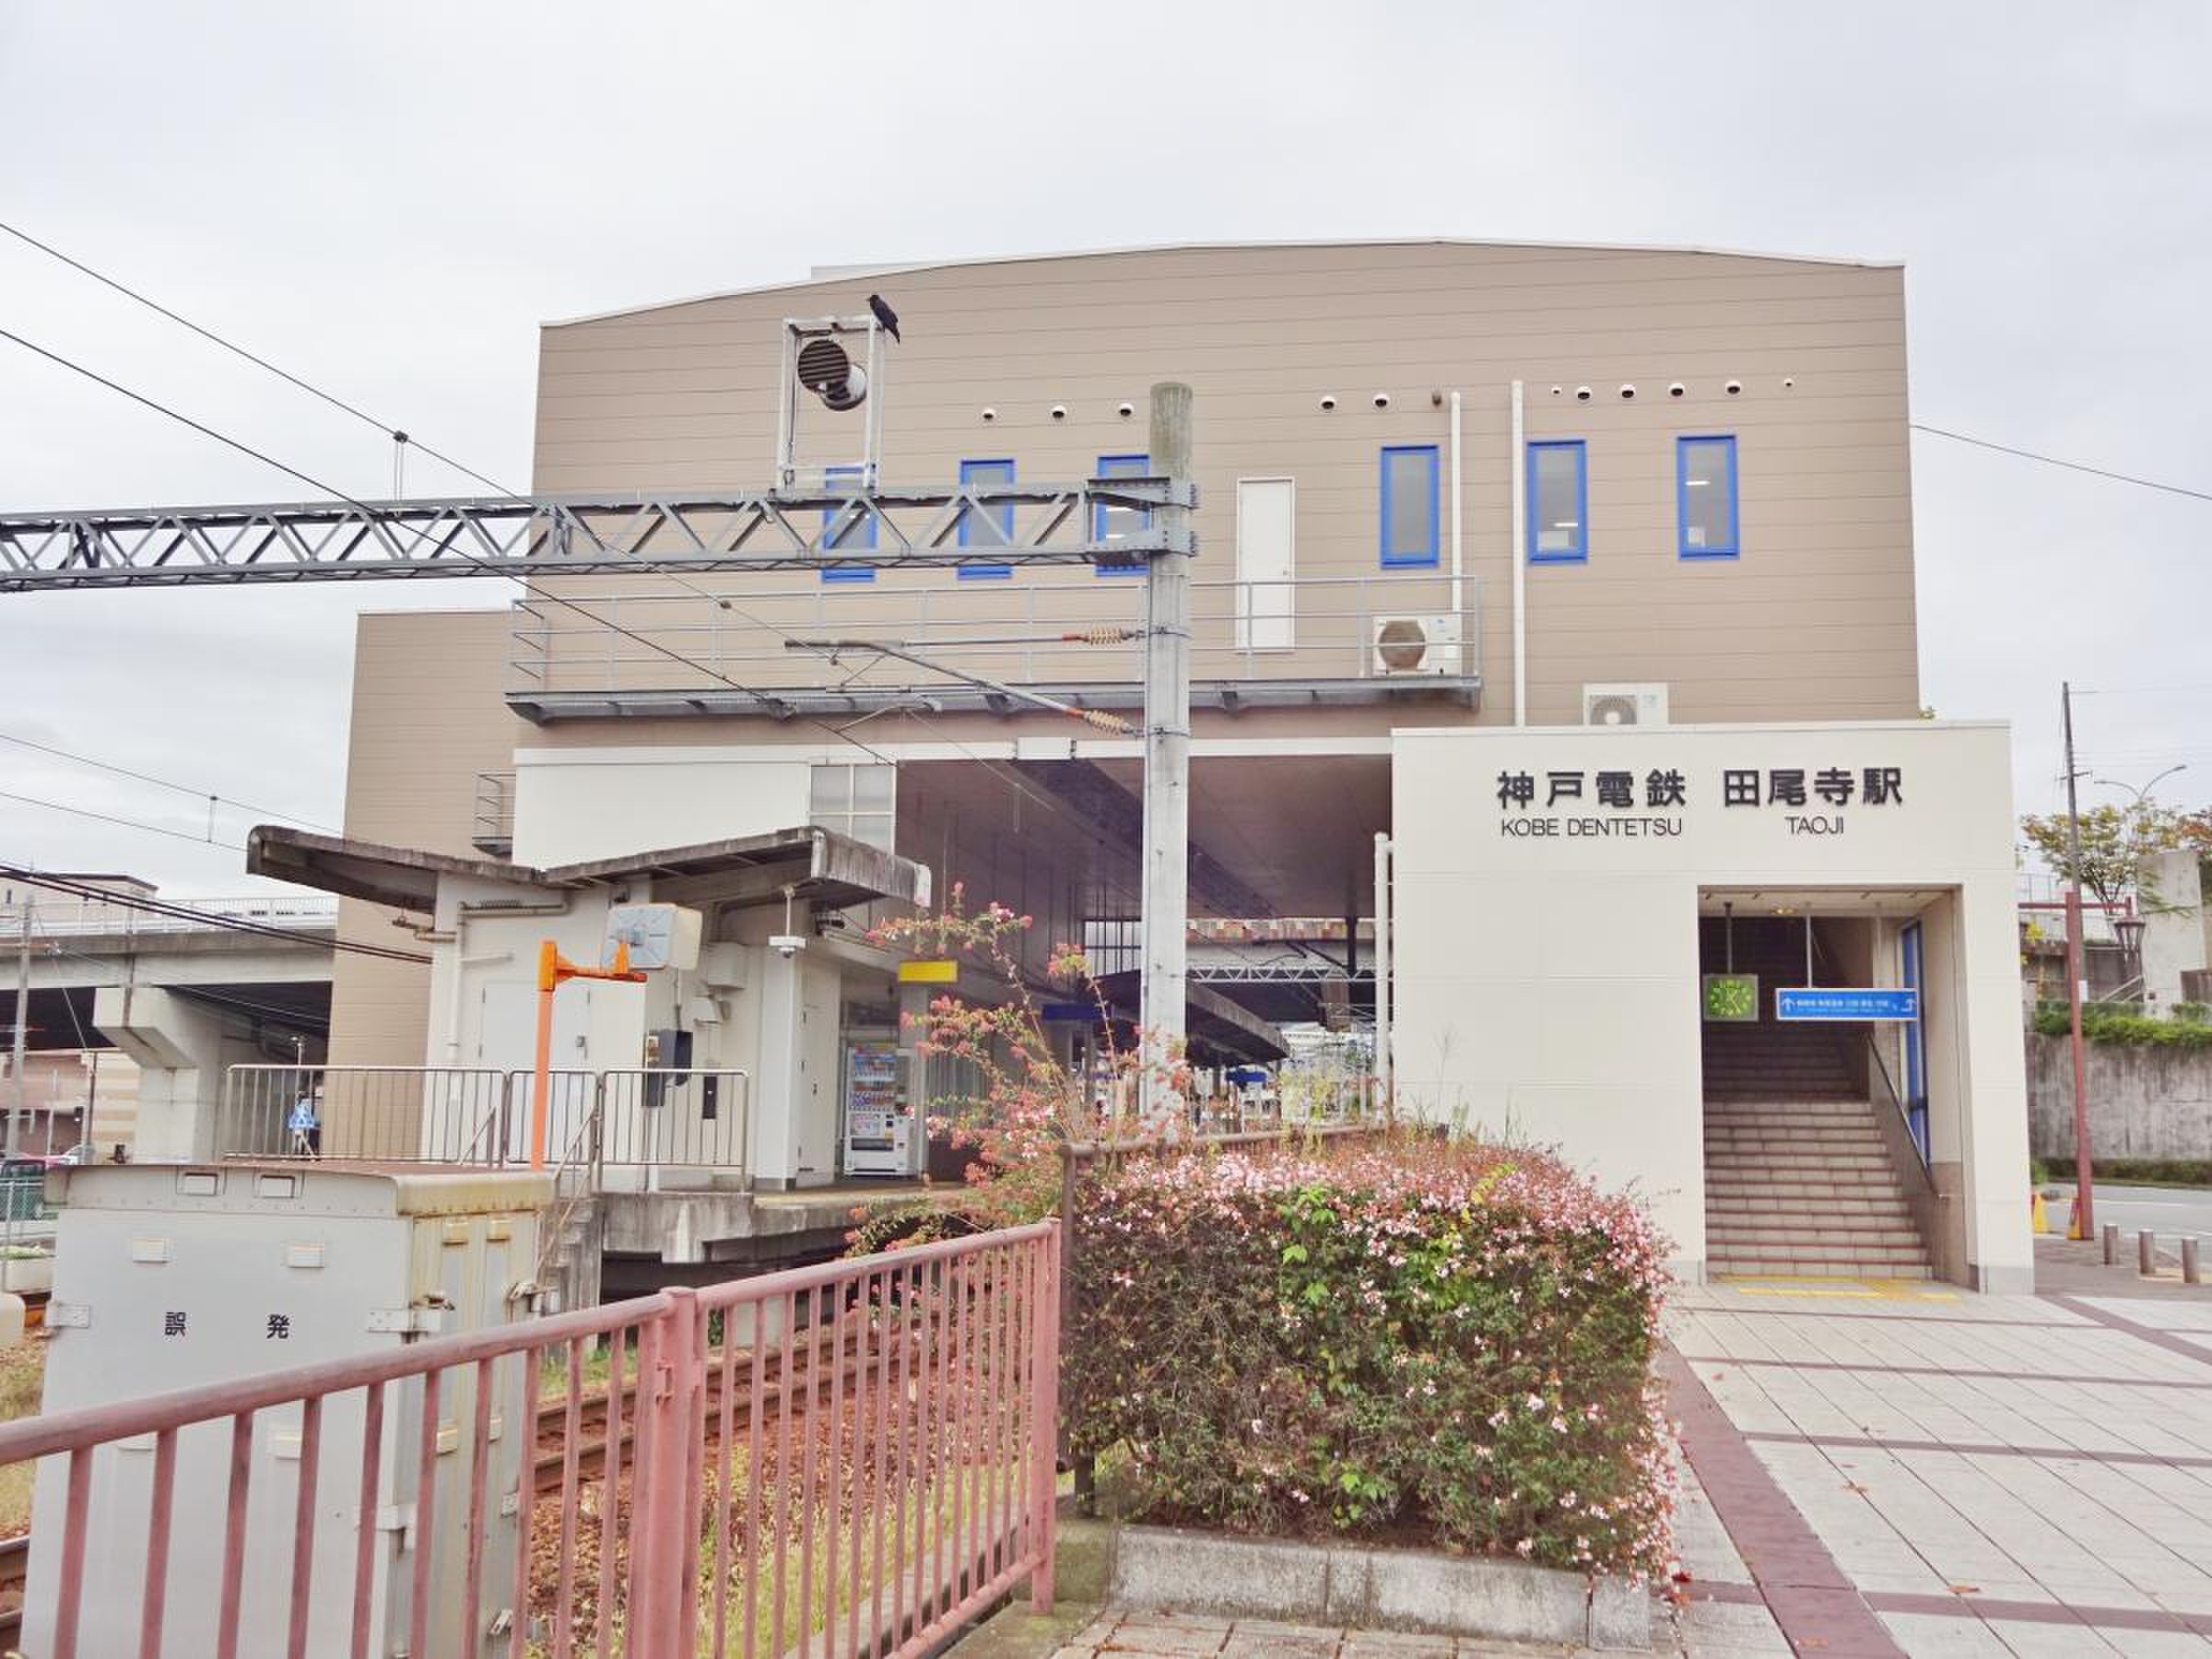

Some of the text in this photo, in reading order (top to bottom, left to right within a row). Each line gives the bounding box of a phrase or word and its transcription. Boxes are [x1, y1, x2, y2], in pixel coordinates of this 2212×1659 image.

[1497, 767, 1904, 808] 神戸電鉄 田尾寺駅
[1501, 818, 1682, 837] KOBE DENTETSU
[1785, 817, 1844, 835] TAOJI
